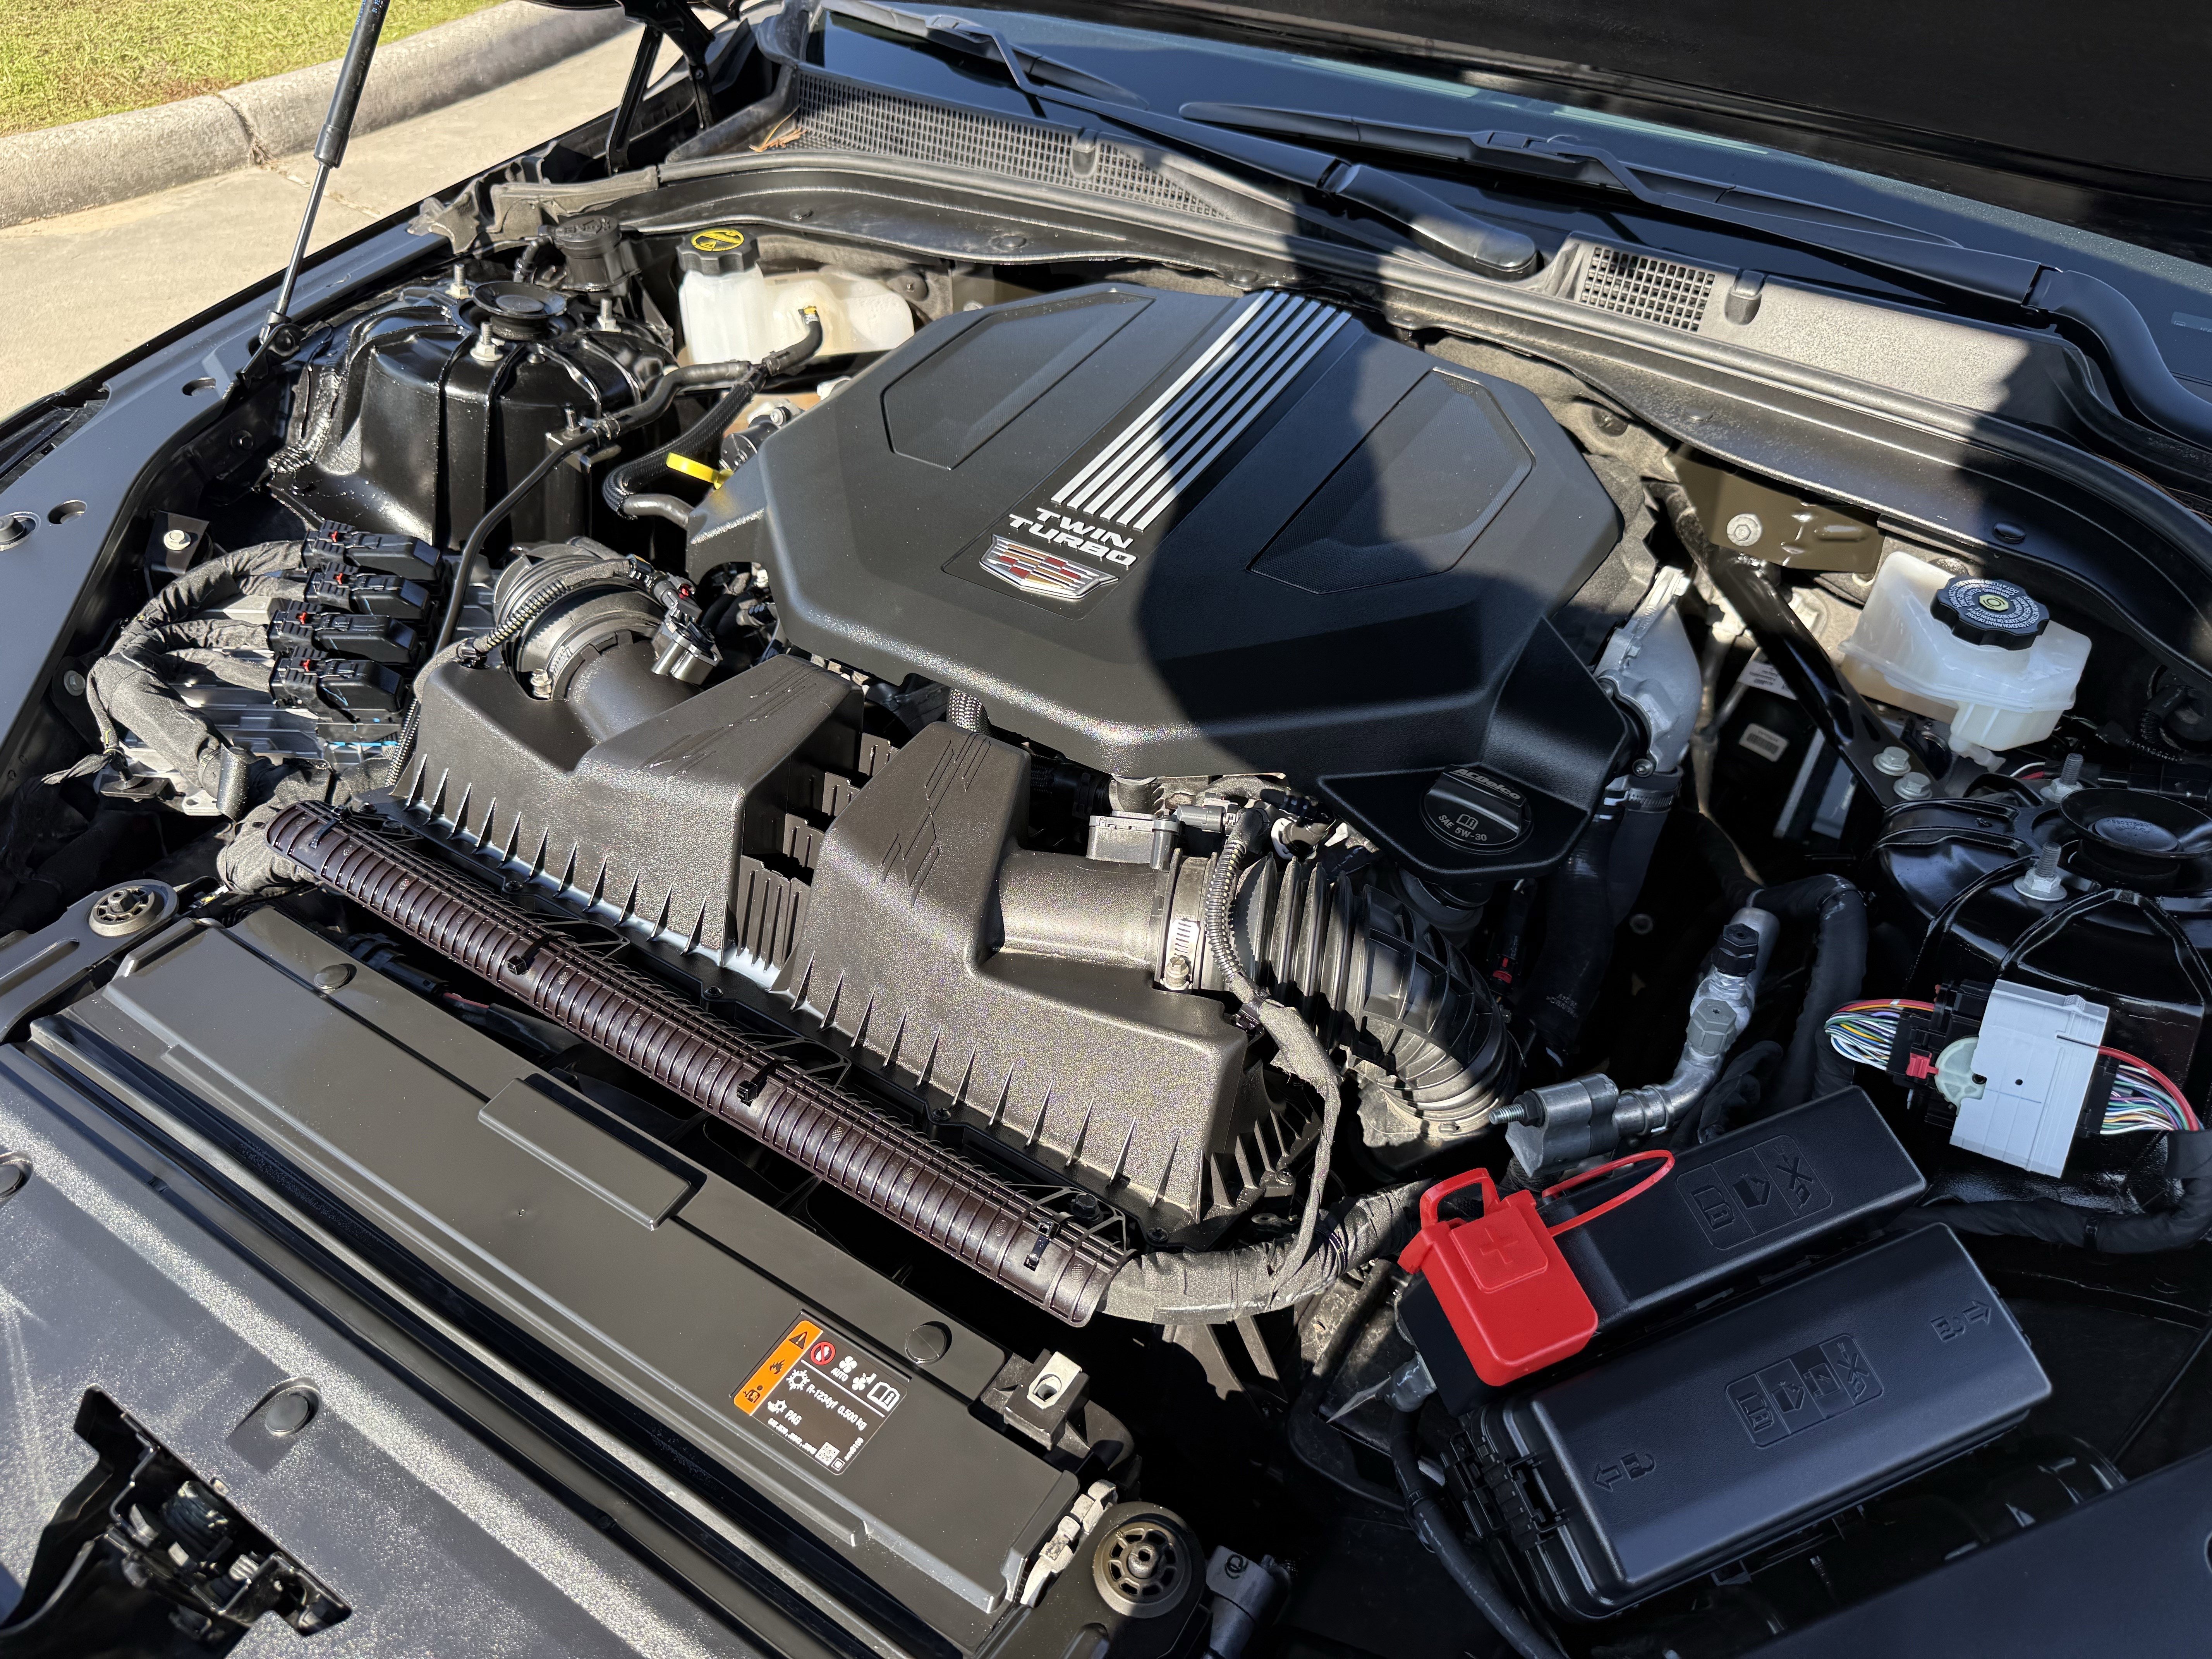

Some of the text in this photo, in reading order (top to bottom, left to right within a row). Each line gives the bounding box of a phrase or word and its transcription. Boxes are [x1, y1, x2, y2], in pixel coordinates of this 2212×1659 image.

[1009, 514, 1137, 566] TURBO
[1036, 507, 1134, 549] TWIN
[1449, 768, 1521, 800] ACDelco
[1438, 814, 1487, 842] SAE 5W-30
[830, 1367, 849, 1382] AUTO
[784, 1410, 802, 1426] PAG
[805, 1384, 867, 1431] R-1234yf 0.500 kg
